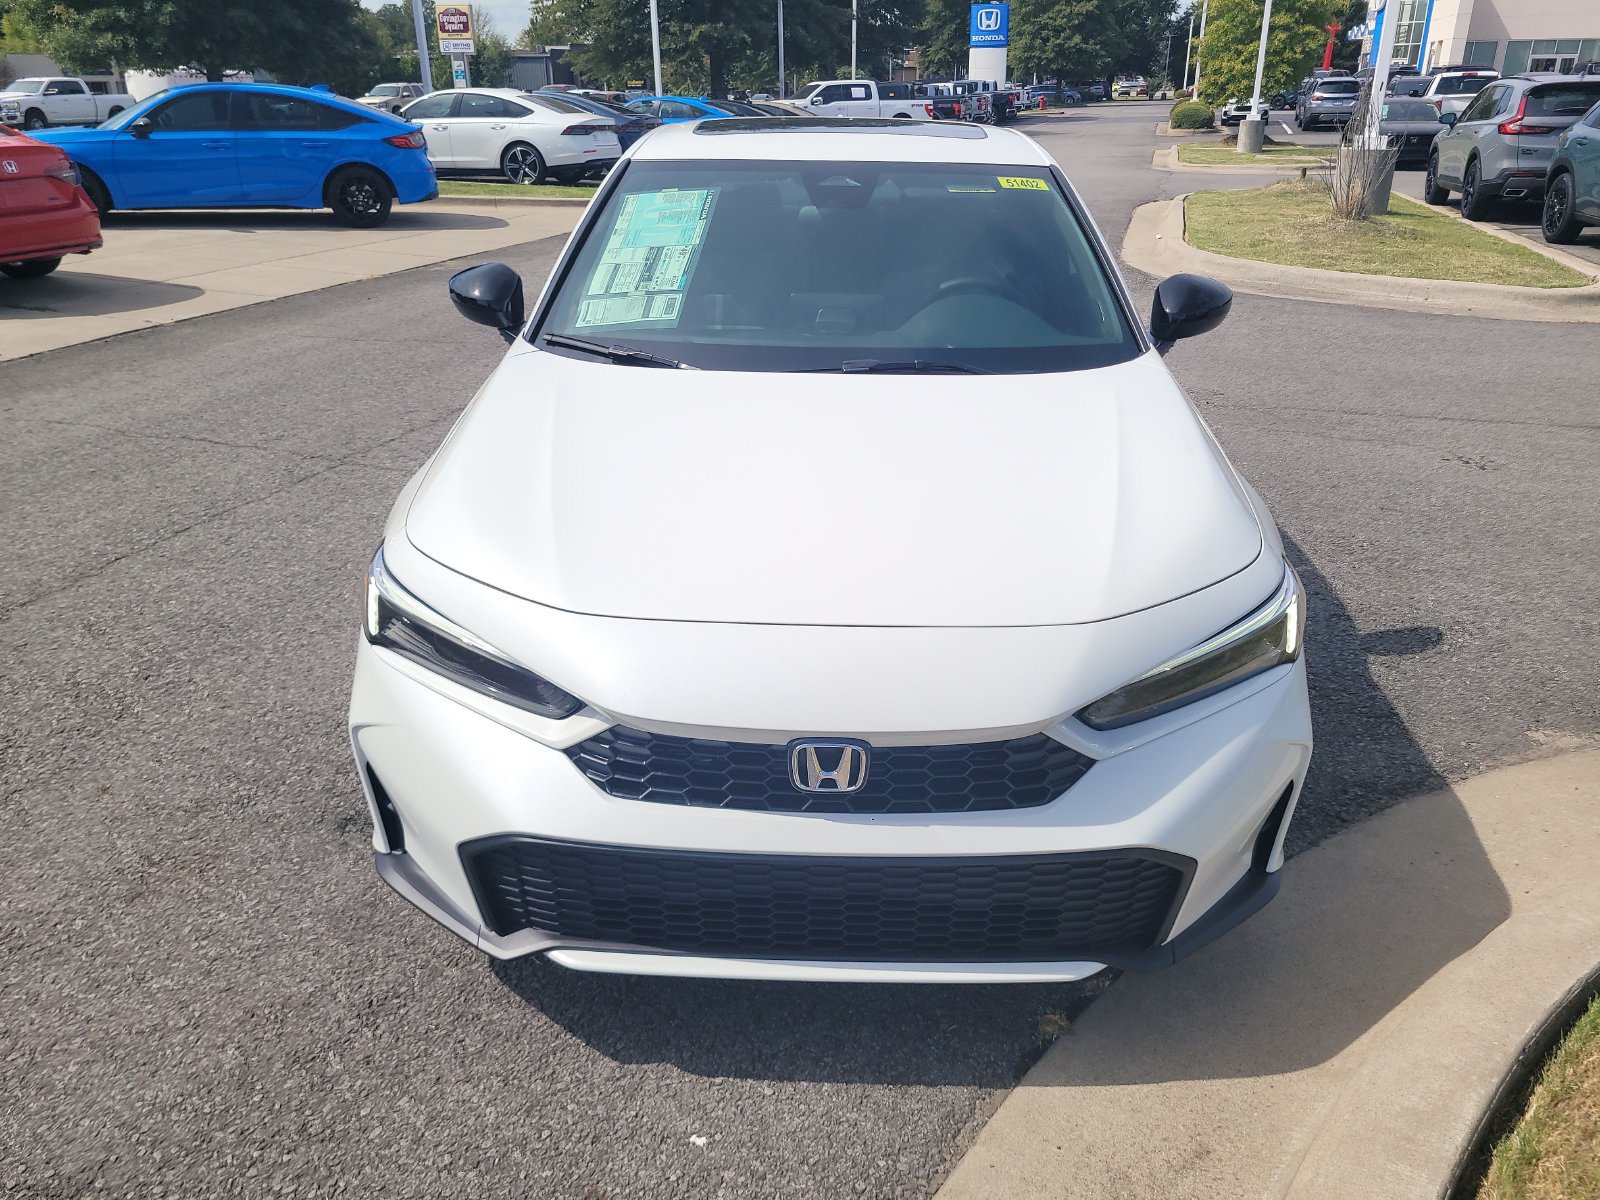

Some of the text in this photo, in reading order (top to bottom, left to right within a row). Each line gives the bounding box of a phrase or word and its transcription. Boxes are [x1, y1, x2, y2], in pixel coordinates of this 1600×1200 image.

[440, 14, 468, 23] Covington
[445, 22, 464, 32] Square
[1005, 178, 1042, 189] 51402
